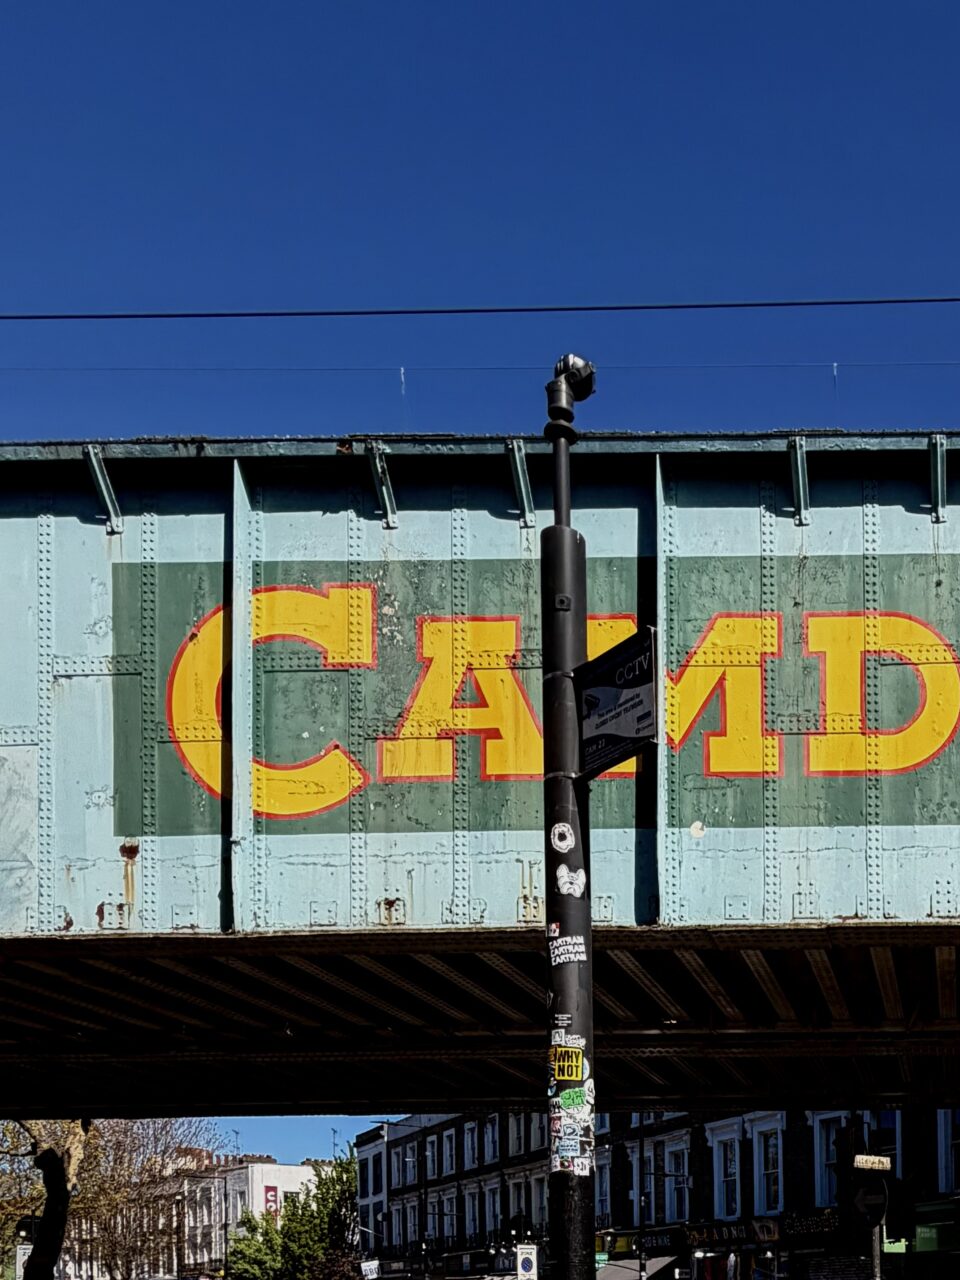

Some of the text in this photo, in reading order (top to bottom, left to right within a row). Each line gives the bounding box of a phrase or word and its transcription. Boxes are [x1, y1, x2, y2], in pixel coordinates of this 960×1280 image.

[615, 653, 651, 685] CCTV
[557, 1049, 581, 1064] WHY
[557, 1064, 580, 1078] NOT
